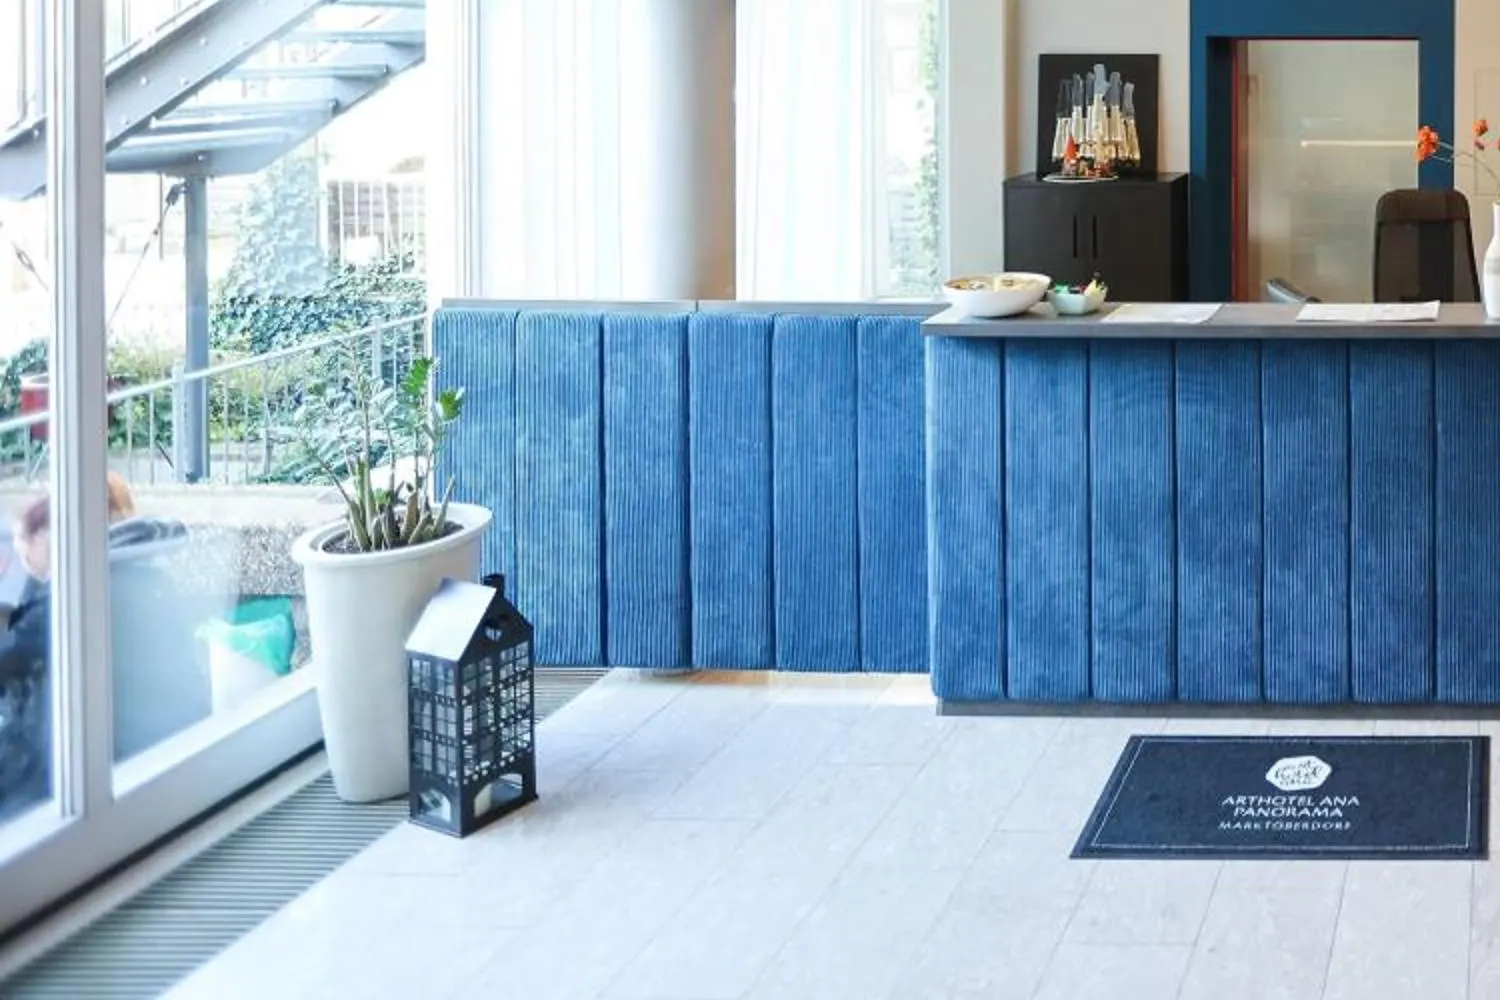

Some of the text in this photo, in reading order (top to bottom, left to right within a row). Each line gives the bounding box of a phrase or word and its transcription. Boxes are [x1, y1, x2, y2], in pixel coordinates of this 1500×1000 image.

[1221, 796, 1360, 806] ARTHOTEL ANA
[1233, 806, 1343, 818] PANORAMA
